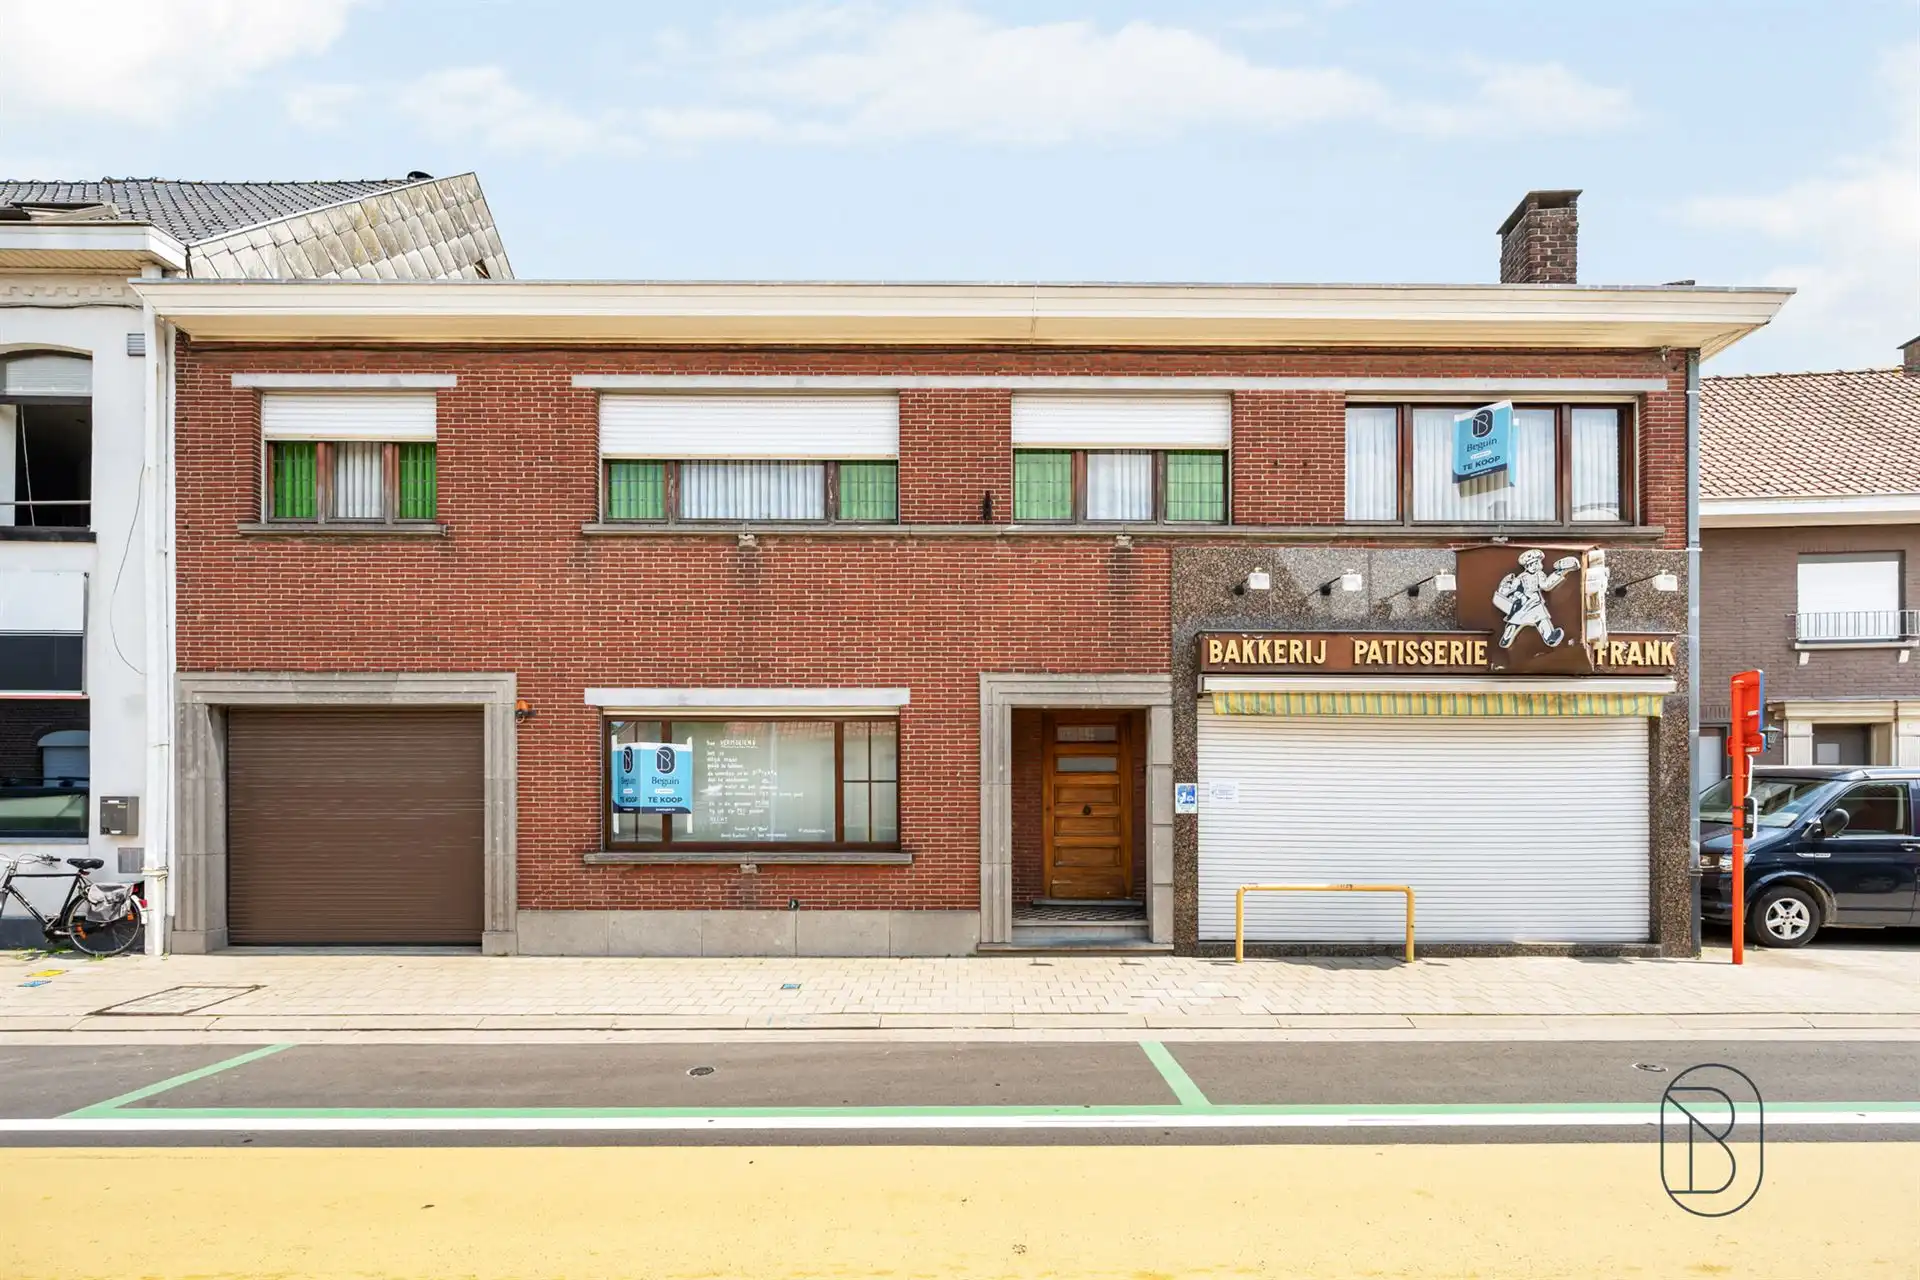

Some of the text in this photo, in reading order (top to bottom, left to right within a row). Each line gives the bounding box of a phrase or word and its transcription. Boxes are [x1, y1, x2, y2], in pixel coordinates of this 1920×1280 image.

[1466, 437, 1498, 453] Beguin
[1462, 455, 1501, 471] TE KOOP
[1208, 639, 1676, 666] BAKKERIJ PATISSERIE FRANK
[651, 776, 680, 787] Beguin
